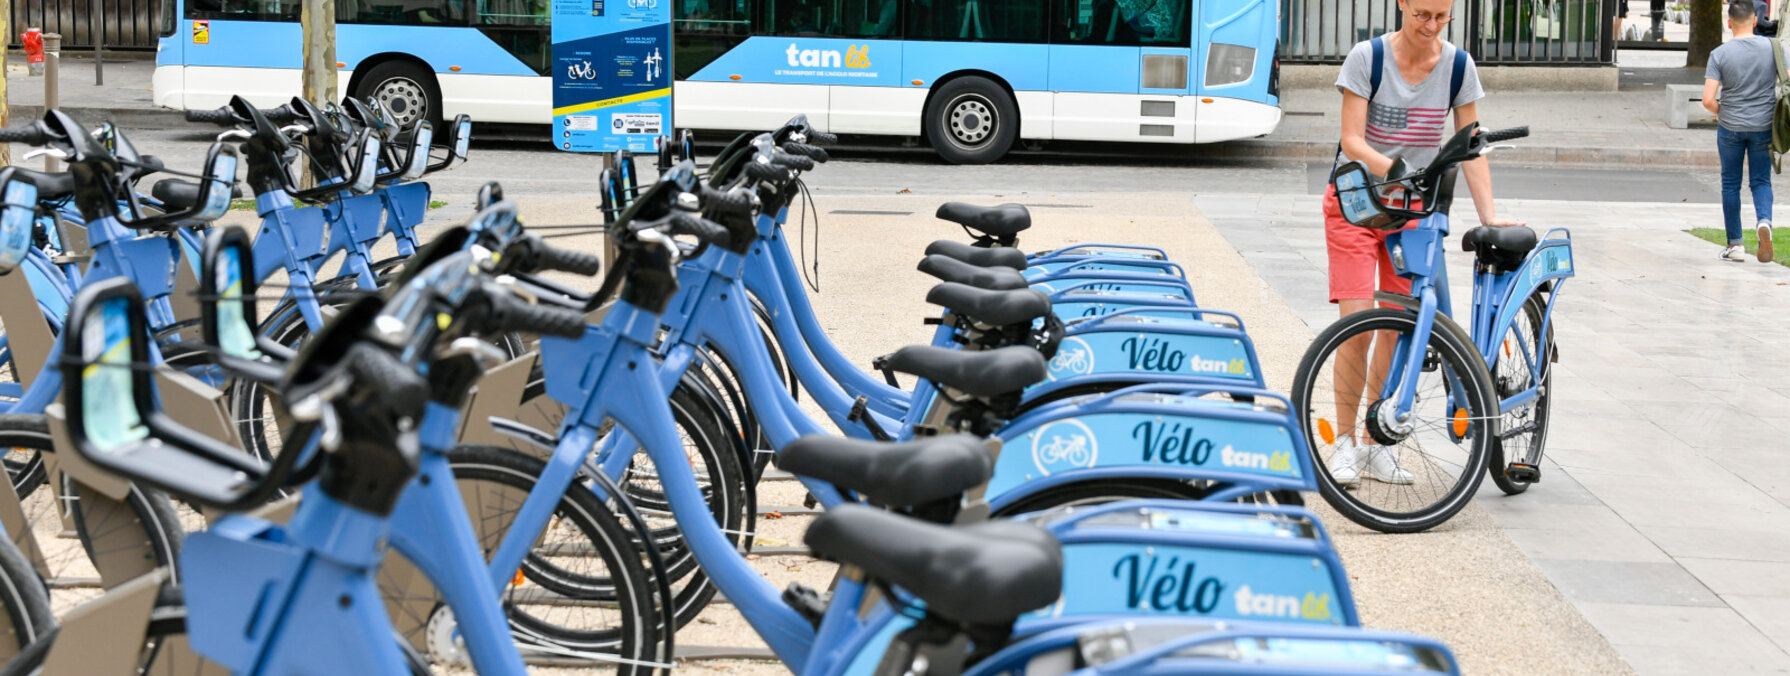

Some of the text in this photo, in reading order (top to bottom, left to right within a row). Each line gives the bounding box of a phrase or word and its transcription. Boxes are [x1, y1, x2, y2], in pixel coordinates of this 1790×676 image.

[785, 43, 872, 69] tan lib
[1121, 337, 1186, 372] Vélo
[1132, 420, 1215, 466] Vélo
[1113, 553, 1227, 614] Vélo
